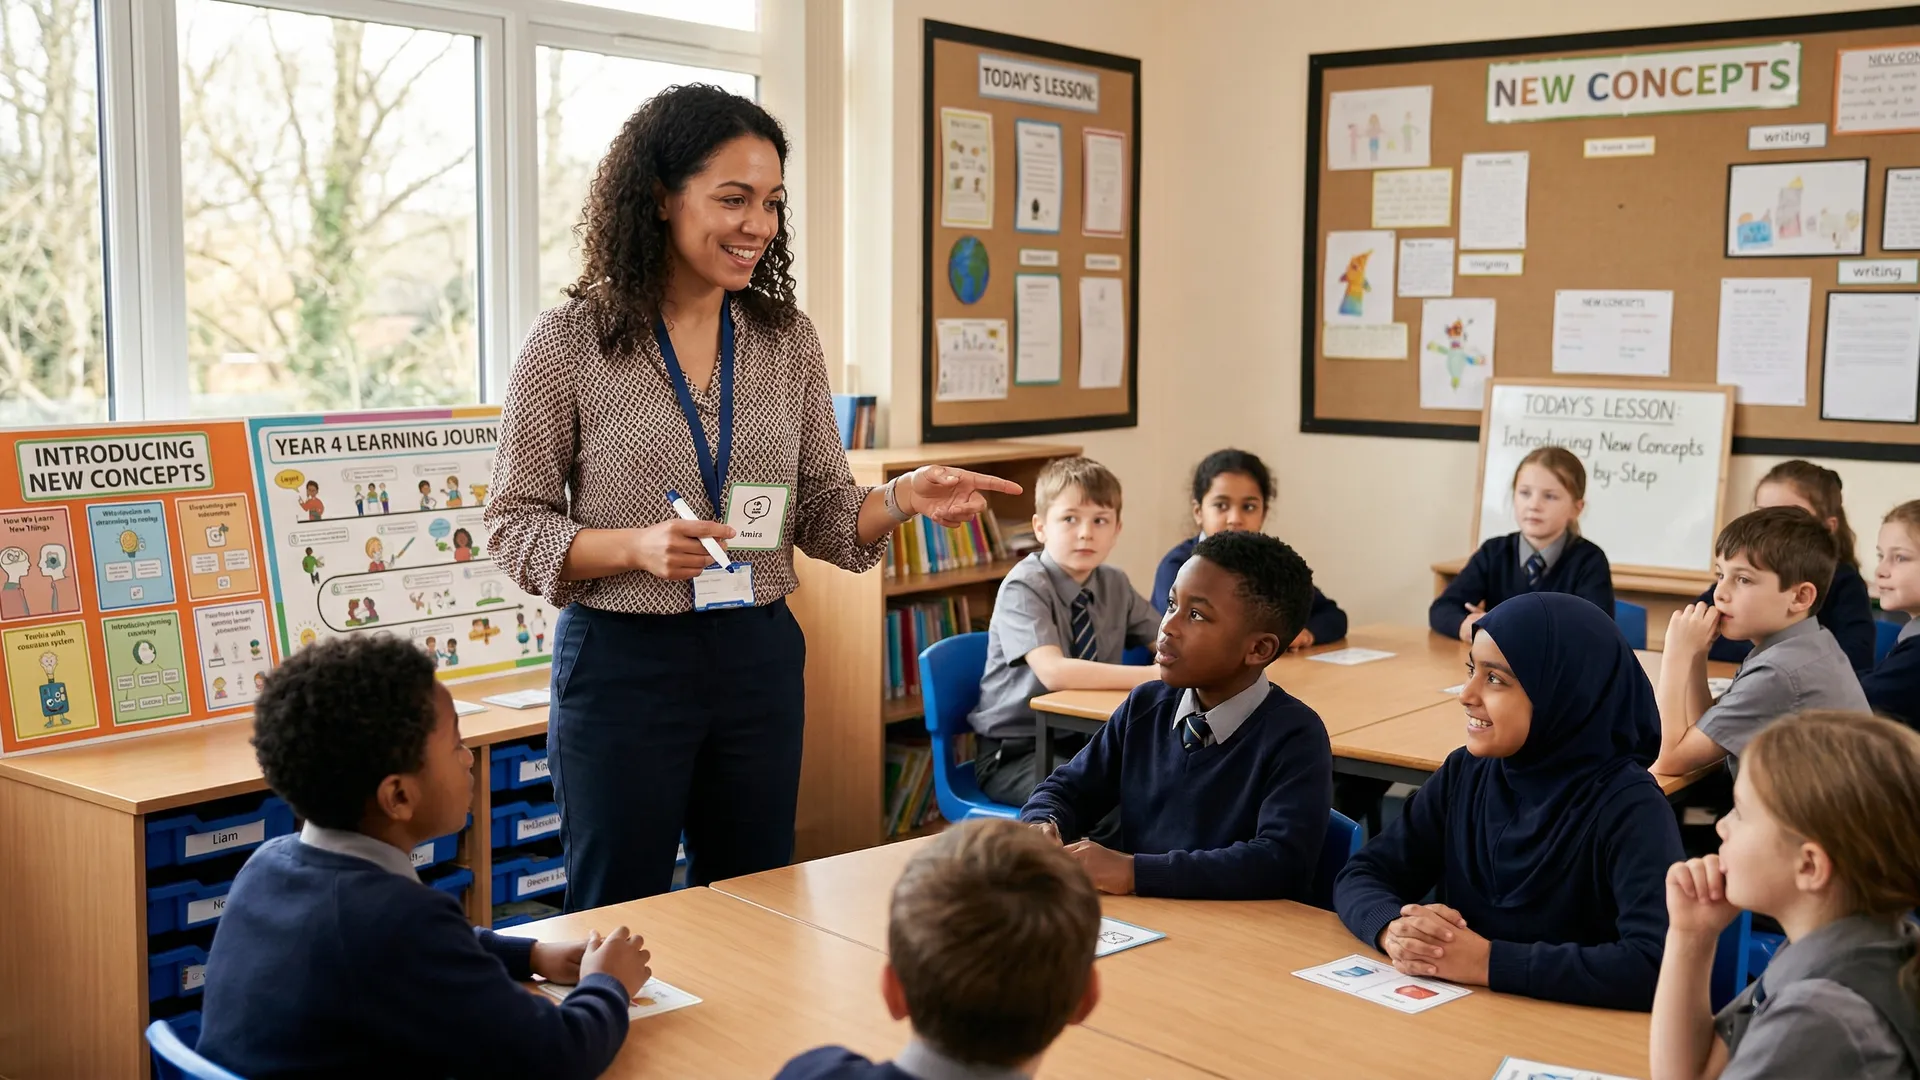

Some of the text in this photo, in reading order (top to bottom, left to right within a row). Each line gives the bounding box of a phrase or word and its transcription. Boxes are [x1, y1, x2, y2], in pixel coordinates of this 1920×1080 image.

[983, 67, 1095, 102] TODAY'S LESSON:
[1494, 59, 1790, 107] NEW CONCEPTS
[1764, 130, 1810, 144] writing
[1853, 265, 1902, 281] writing
[1524, 394, 1594, 416] TODAY'S
[35, 440, 195, 467] INTRODUCING
[275, 428, 498, 456] YEAR 4 LEARNING JOURN
[1599, 431, 1630, 451] New
[1637, 433, 1704, 463] Concepts
[29, 464, 206, 493] NEW CONCEPTS
[1593, 462, 1657, 491] by-Step
[213, 832, 238, 845] Liam
